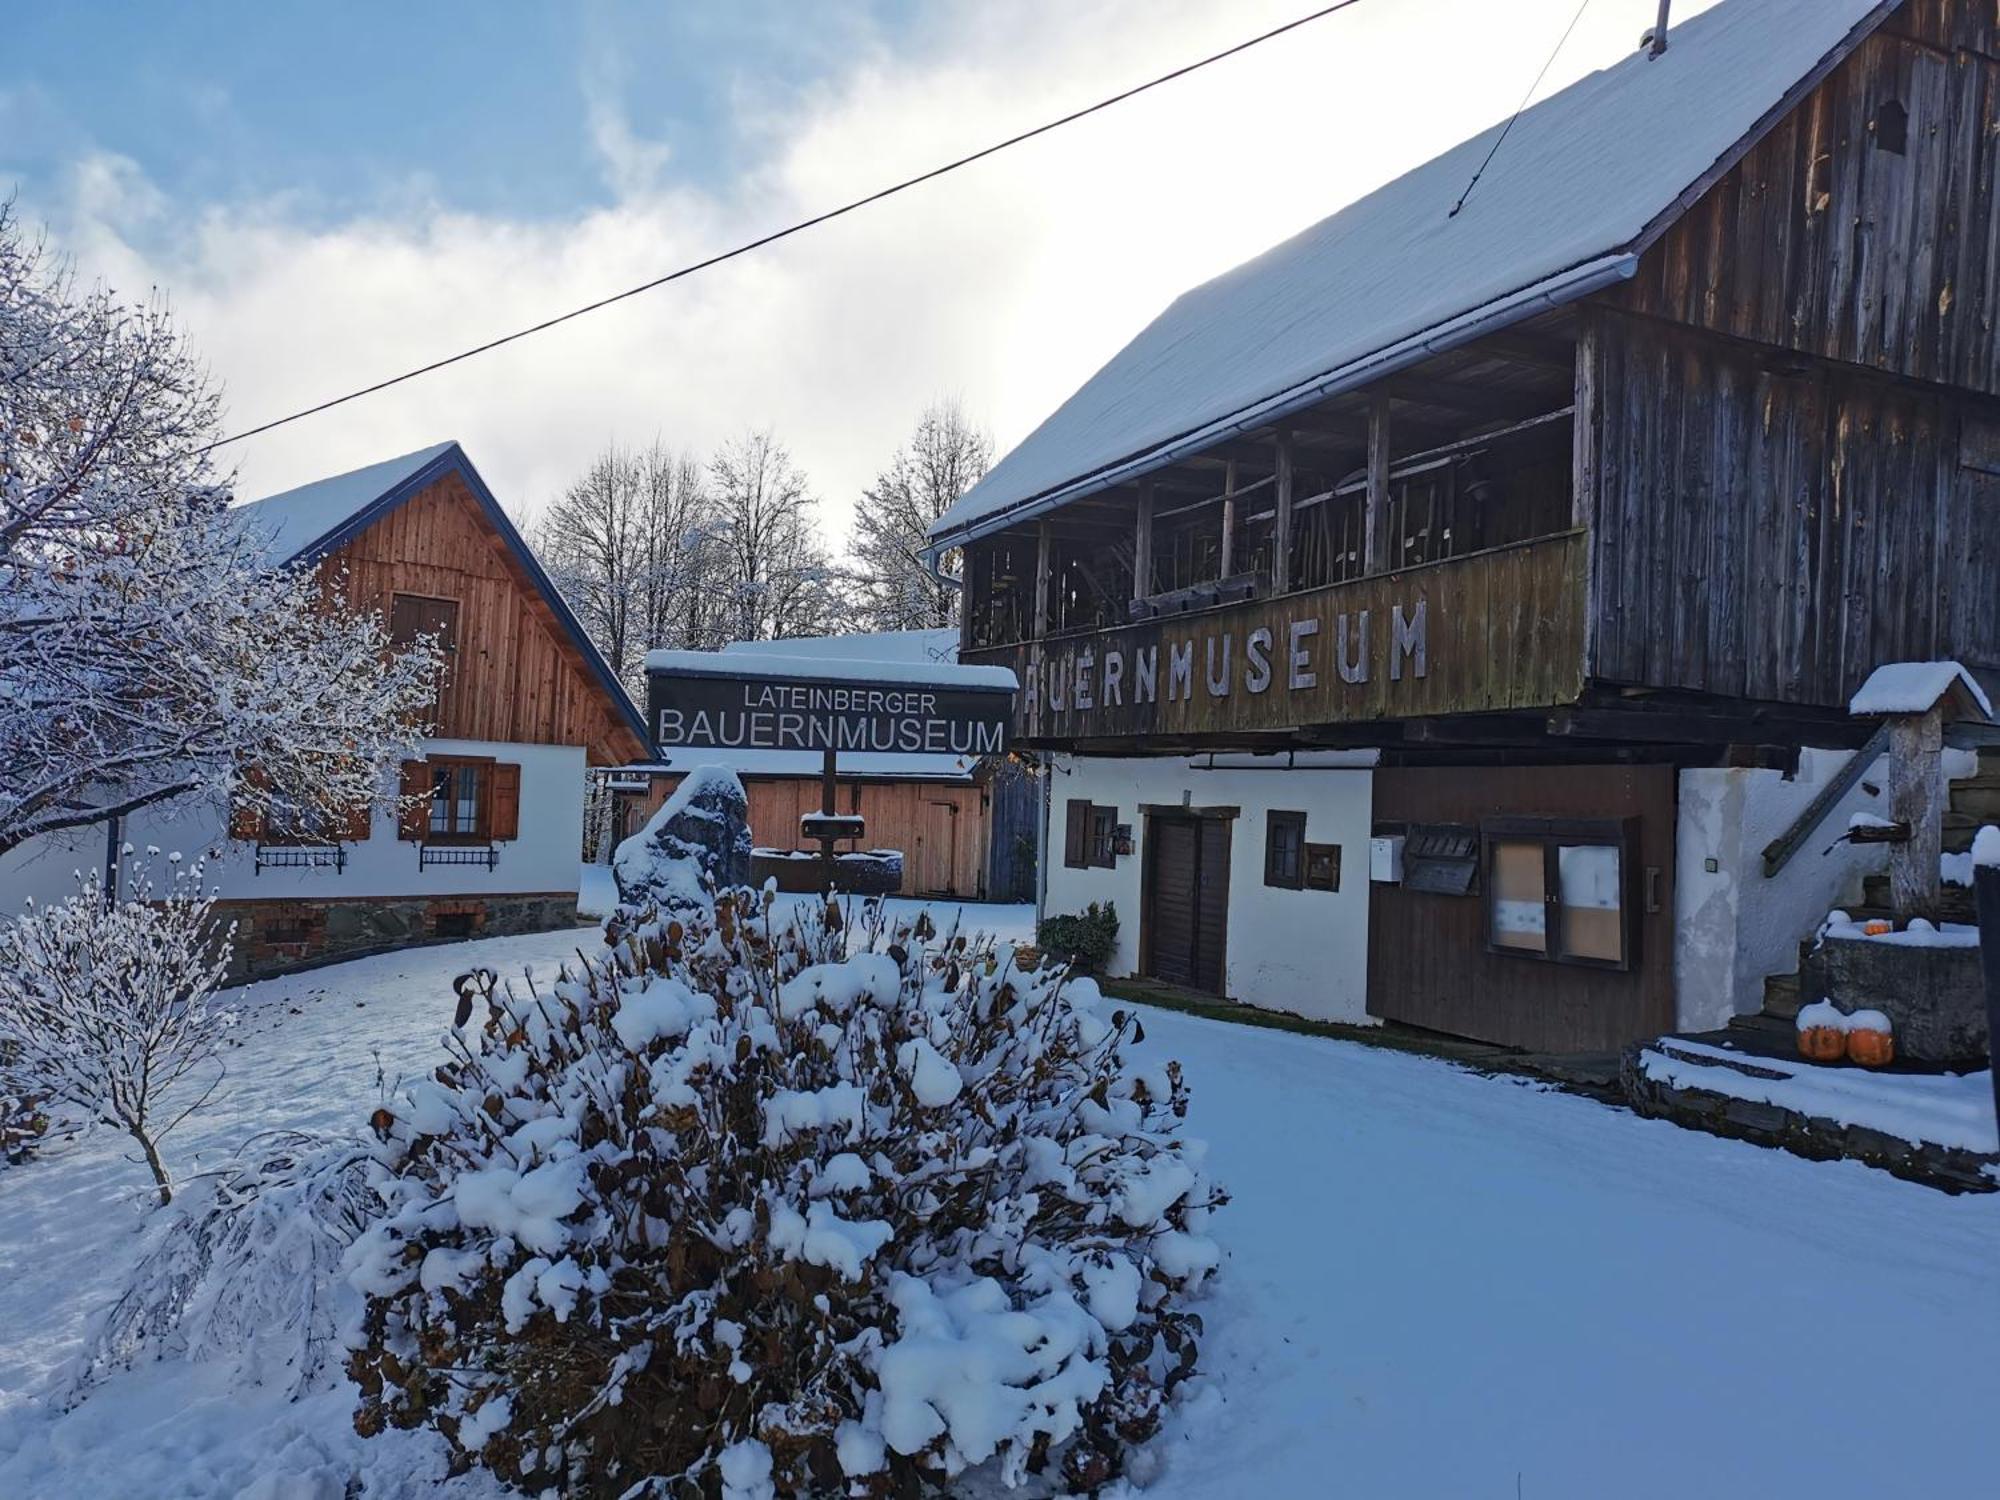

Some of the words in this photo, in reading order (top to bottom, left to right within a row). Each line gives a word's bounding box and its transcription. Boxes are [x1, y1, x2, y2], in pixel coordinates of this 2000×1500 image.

[1011, 599, 1427, 715] AUERNMUSEUM
[744, 684, 936, 715] LATEINBERGER
[658, 709, 1004, 753] BAUERNMUSEUM
